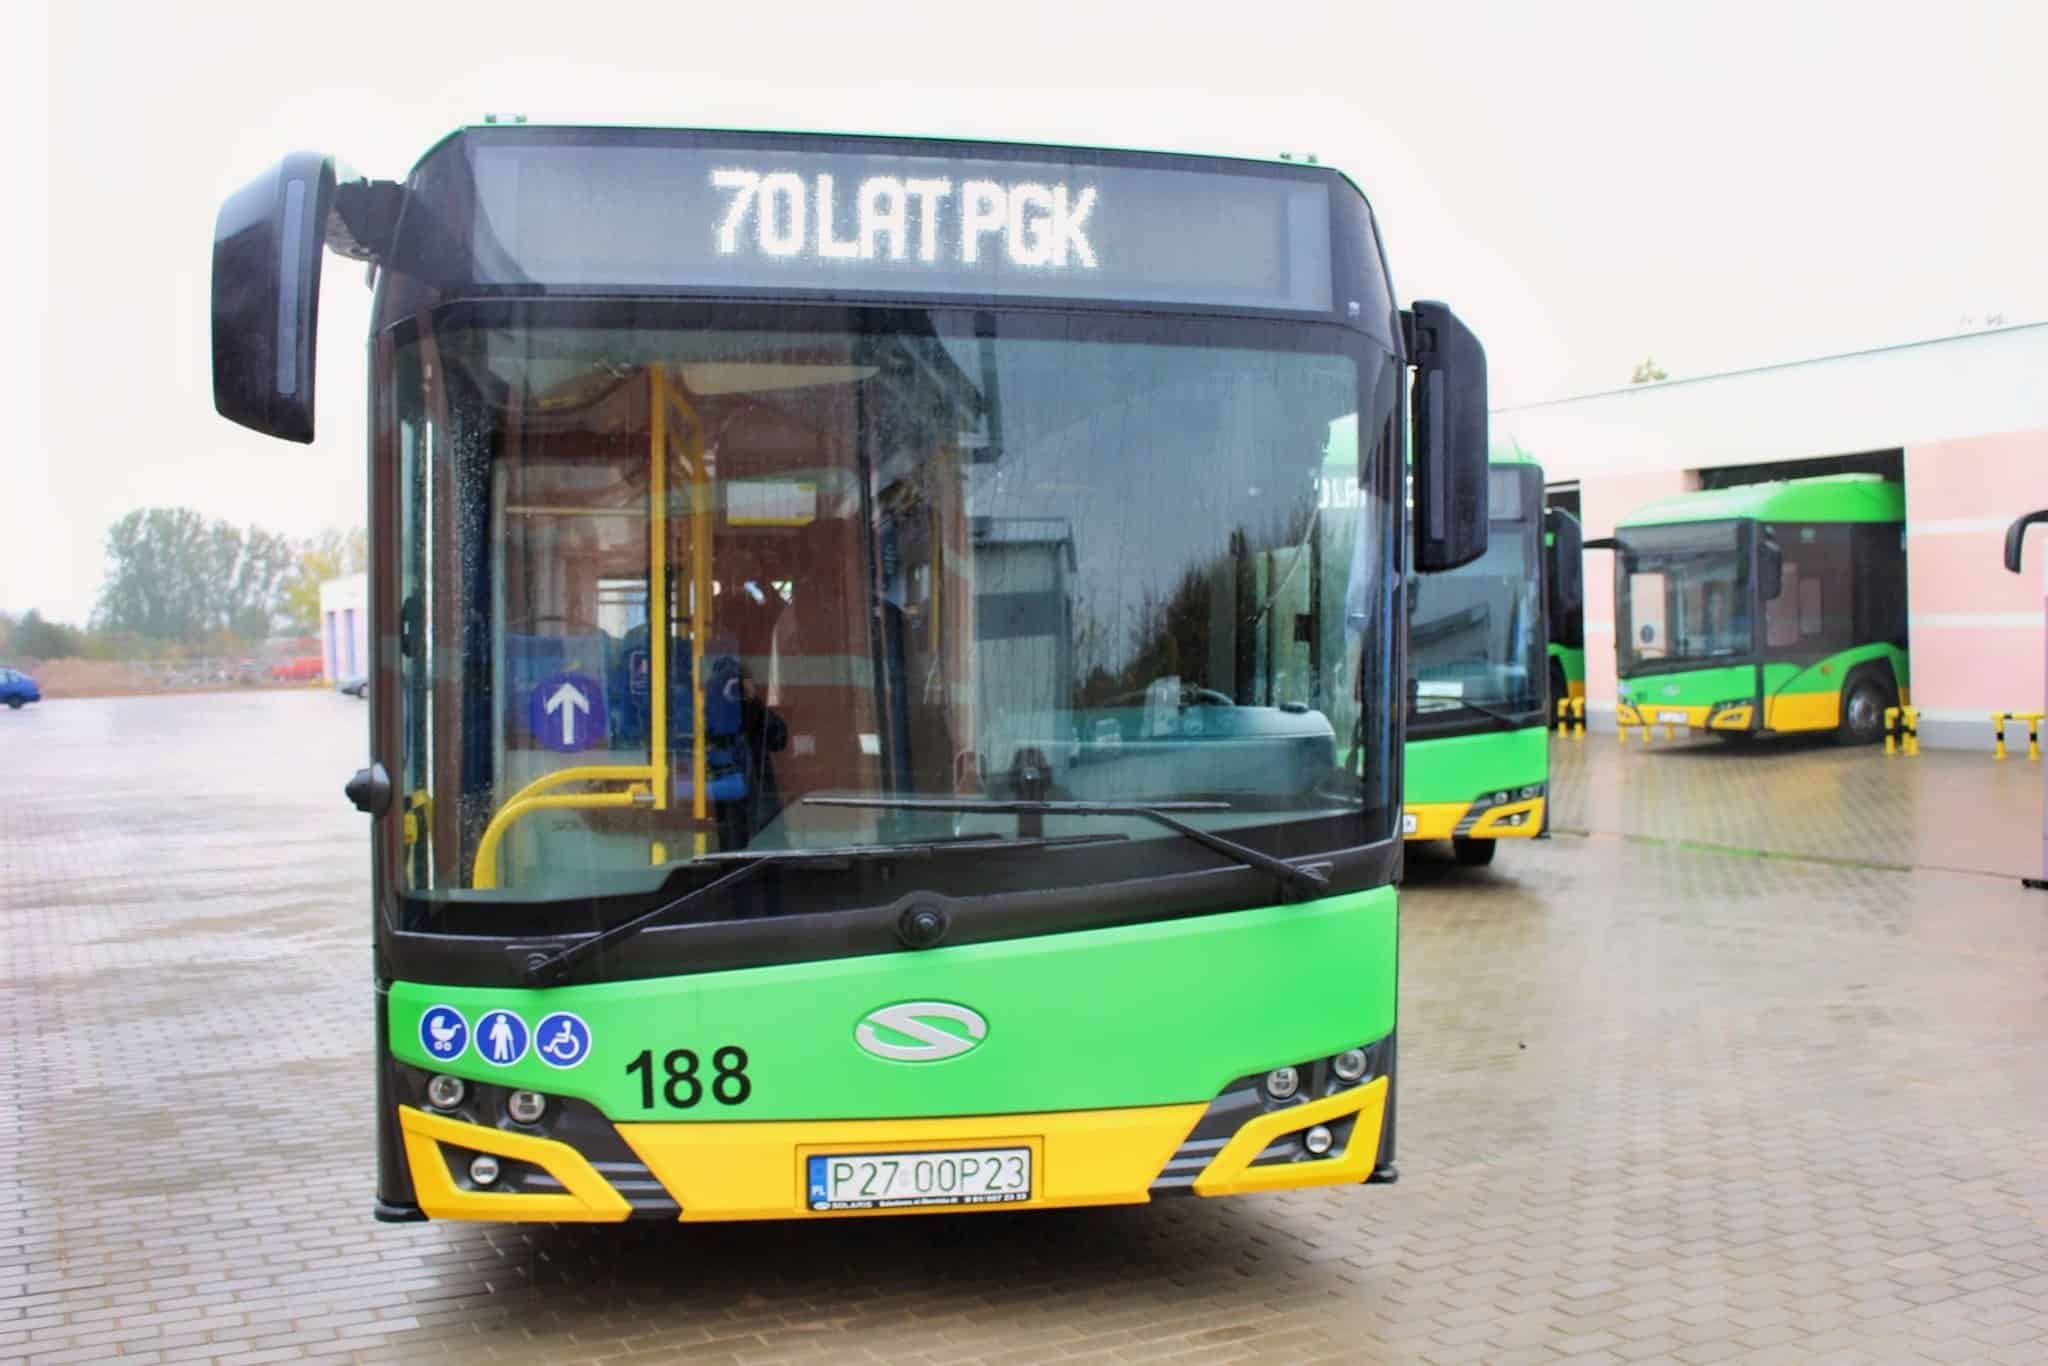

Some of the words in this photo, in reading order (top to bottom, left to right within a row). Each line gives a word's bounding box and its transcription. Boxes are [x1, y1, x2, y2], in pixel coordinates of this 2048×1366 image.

[711, 168, 805, 255] 70
[817, 172, 952, 262] LAT
[962, 180, 1098, 268] PGK
[625, 1046, 752, 1109] 188
[811, 1184, 826, 1196] PL
[833, 1161, 899, 1197] P27
[914, 1155, 1025, 1193] 00P23
